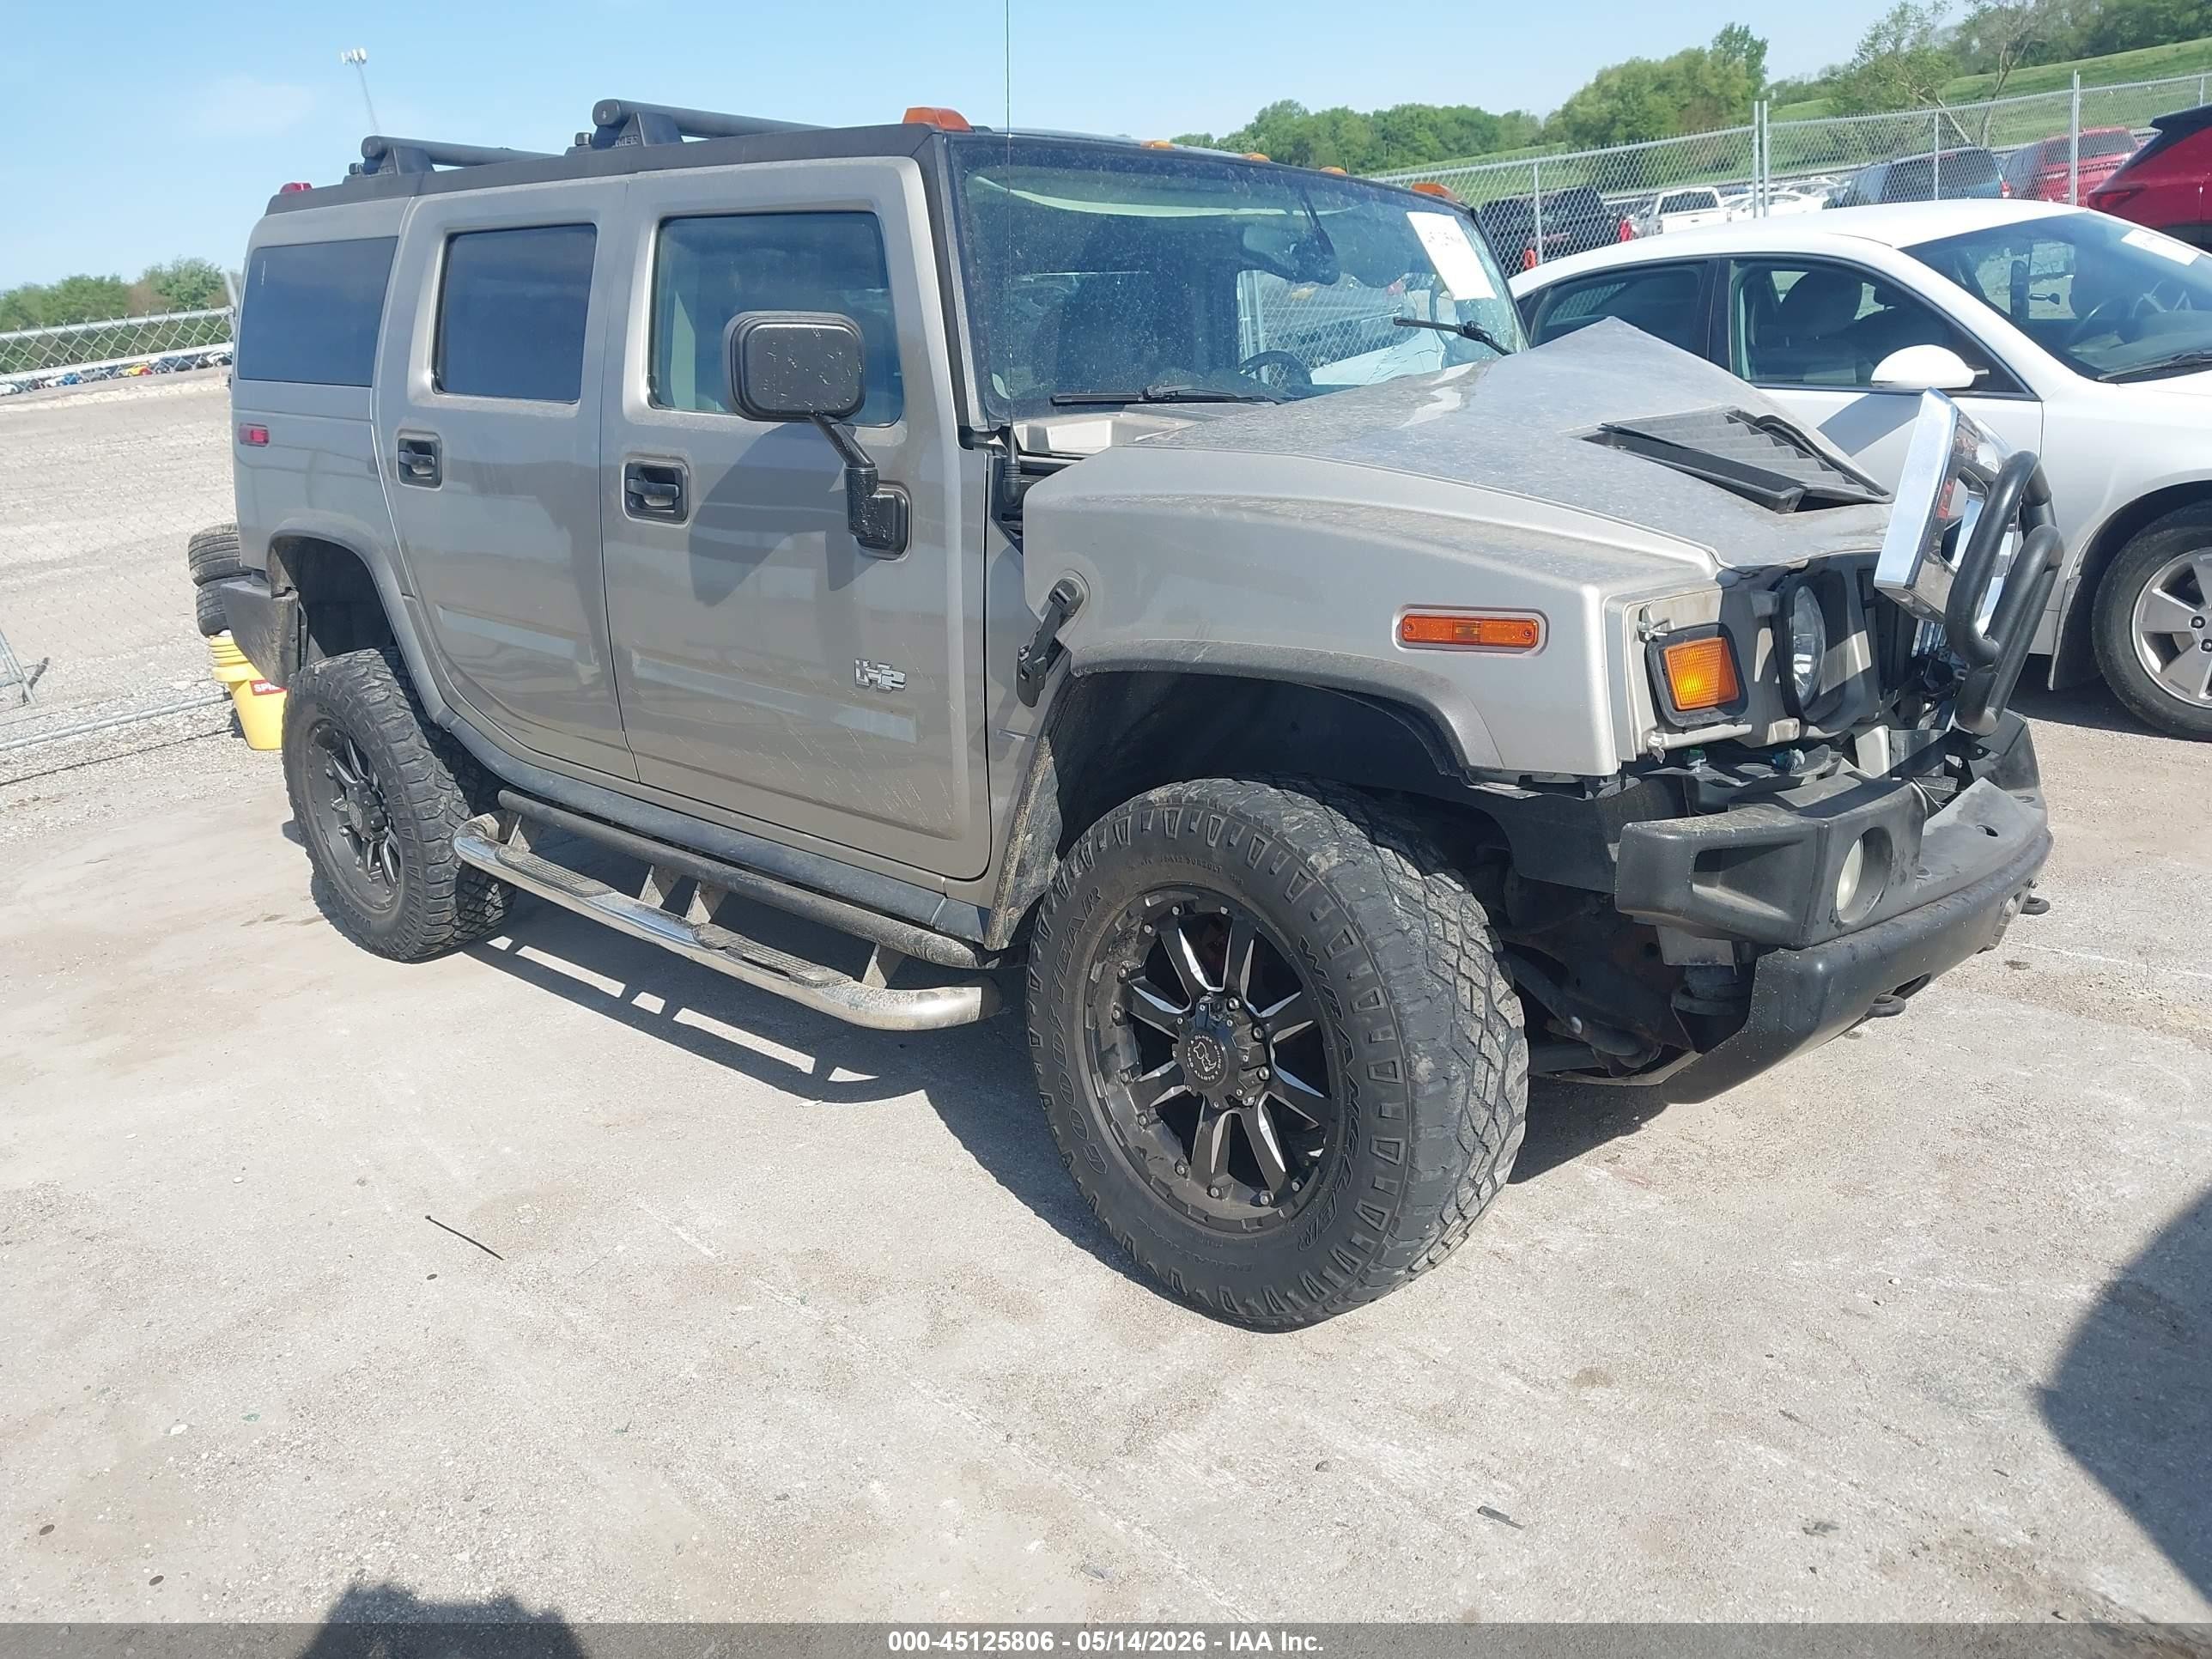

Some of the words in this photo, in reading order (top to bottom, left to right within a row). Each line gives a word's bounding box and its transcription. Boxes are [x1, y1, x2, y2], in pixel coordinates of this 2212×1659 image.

[854, 658, 906, 692] H2
[1048, 885, 1108, 1175] GOODYEAR
[1297, 934, 1361, 1252] WRANGLER
